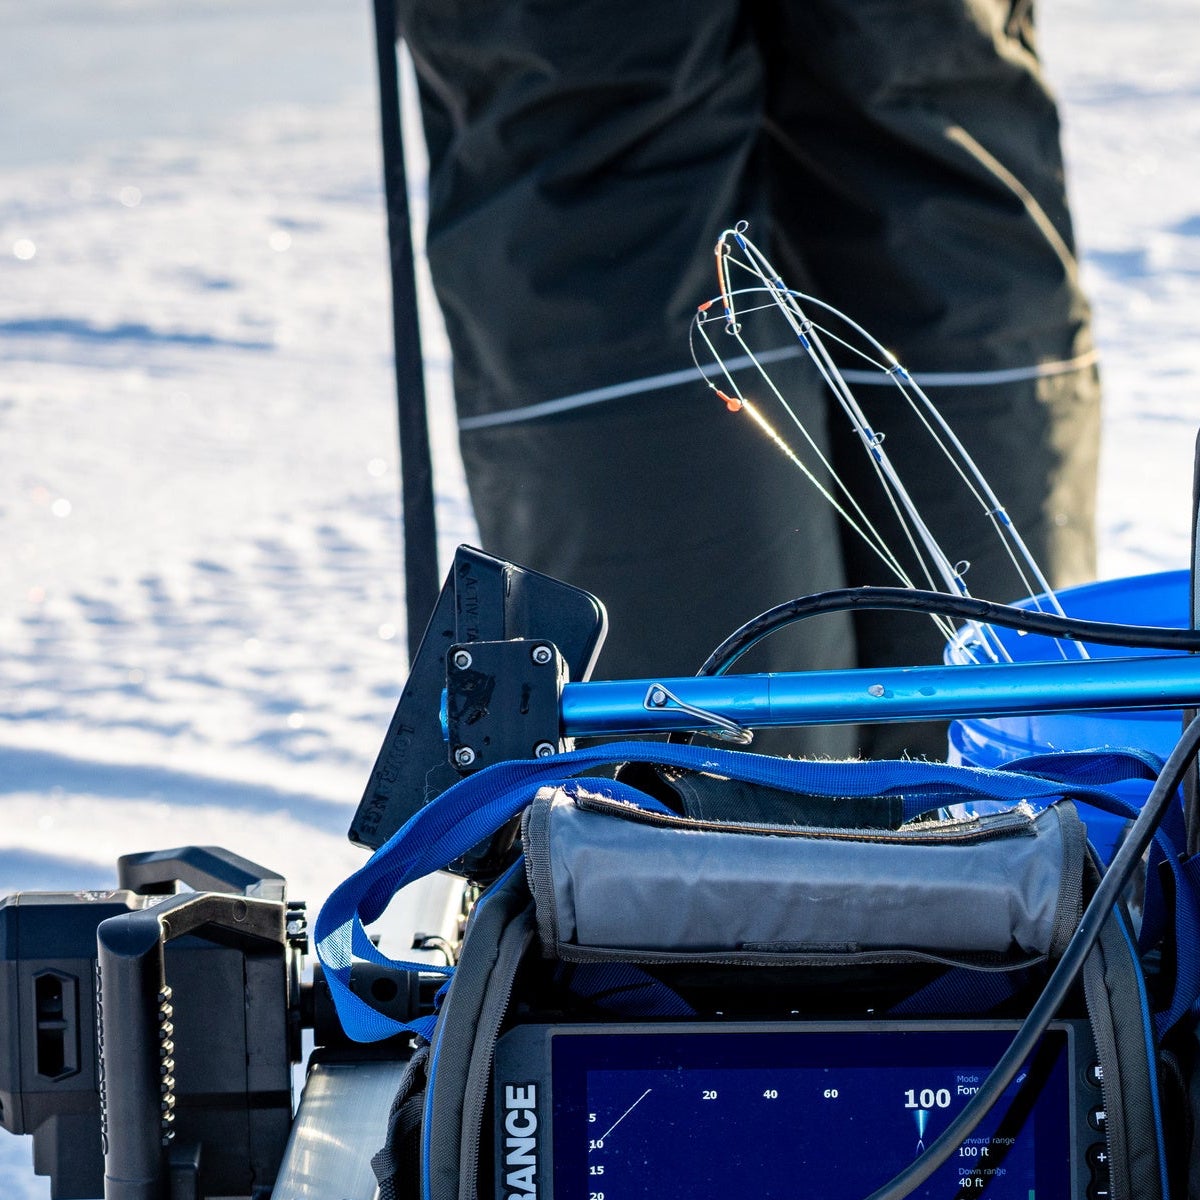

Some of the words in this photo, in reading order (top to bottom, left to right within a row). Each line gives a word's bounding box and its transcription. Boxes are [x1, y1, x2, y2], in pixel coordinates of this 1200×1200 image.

[957, 1075, 979, 1083] Mode
[702, 1090, 718, 1100] 20
[763, 1089, 779, 1099] 40
[823, 1089, 839, 1098] 60
[904, 1088, 951, 1108] 100
[588, 1113, 597, 1122] 5
[589, 1140, 604, 1149] 10
[992, 1137, 1015, 1146] range
[959, 1146, 978, 1157] 100
[980, 1146, 989, 1157] ft
[589, 1166, 605, 1175] 15
[983, 1168, 1007, 1177] range
[958, 1177, 972, 1188] 40
[975, 1177, 983, 1188] ft
